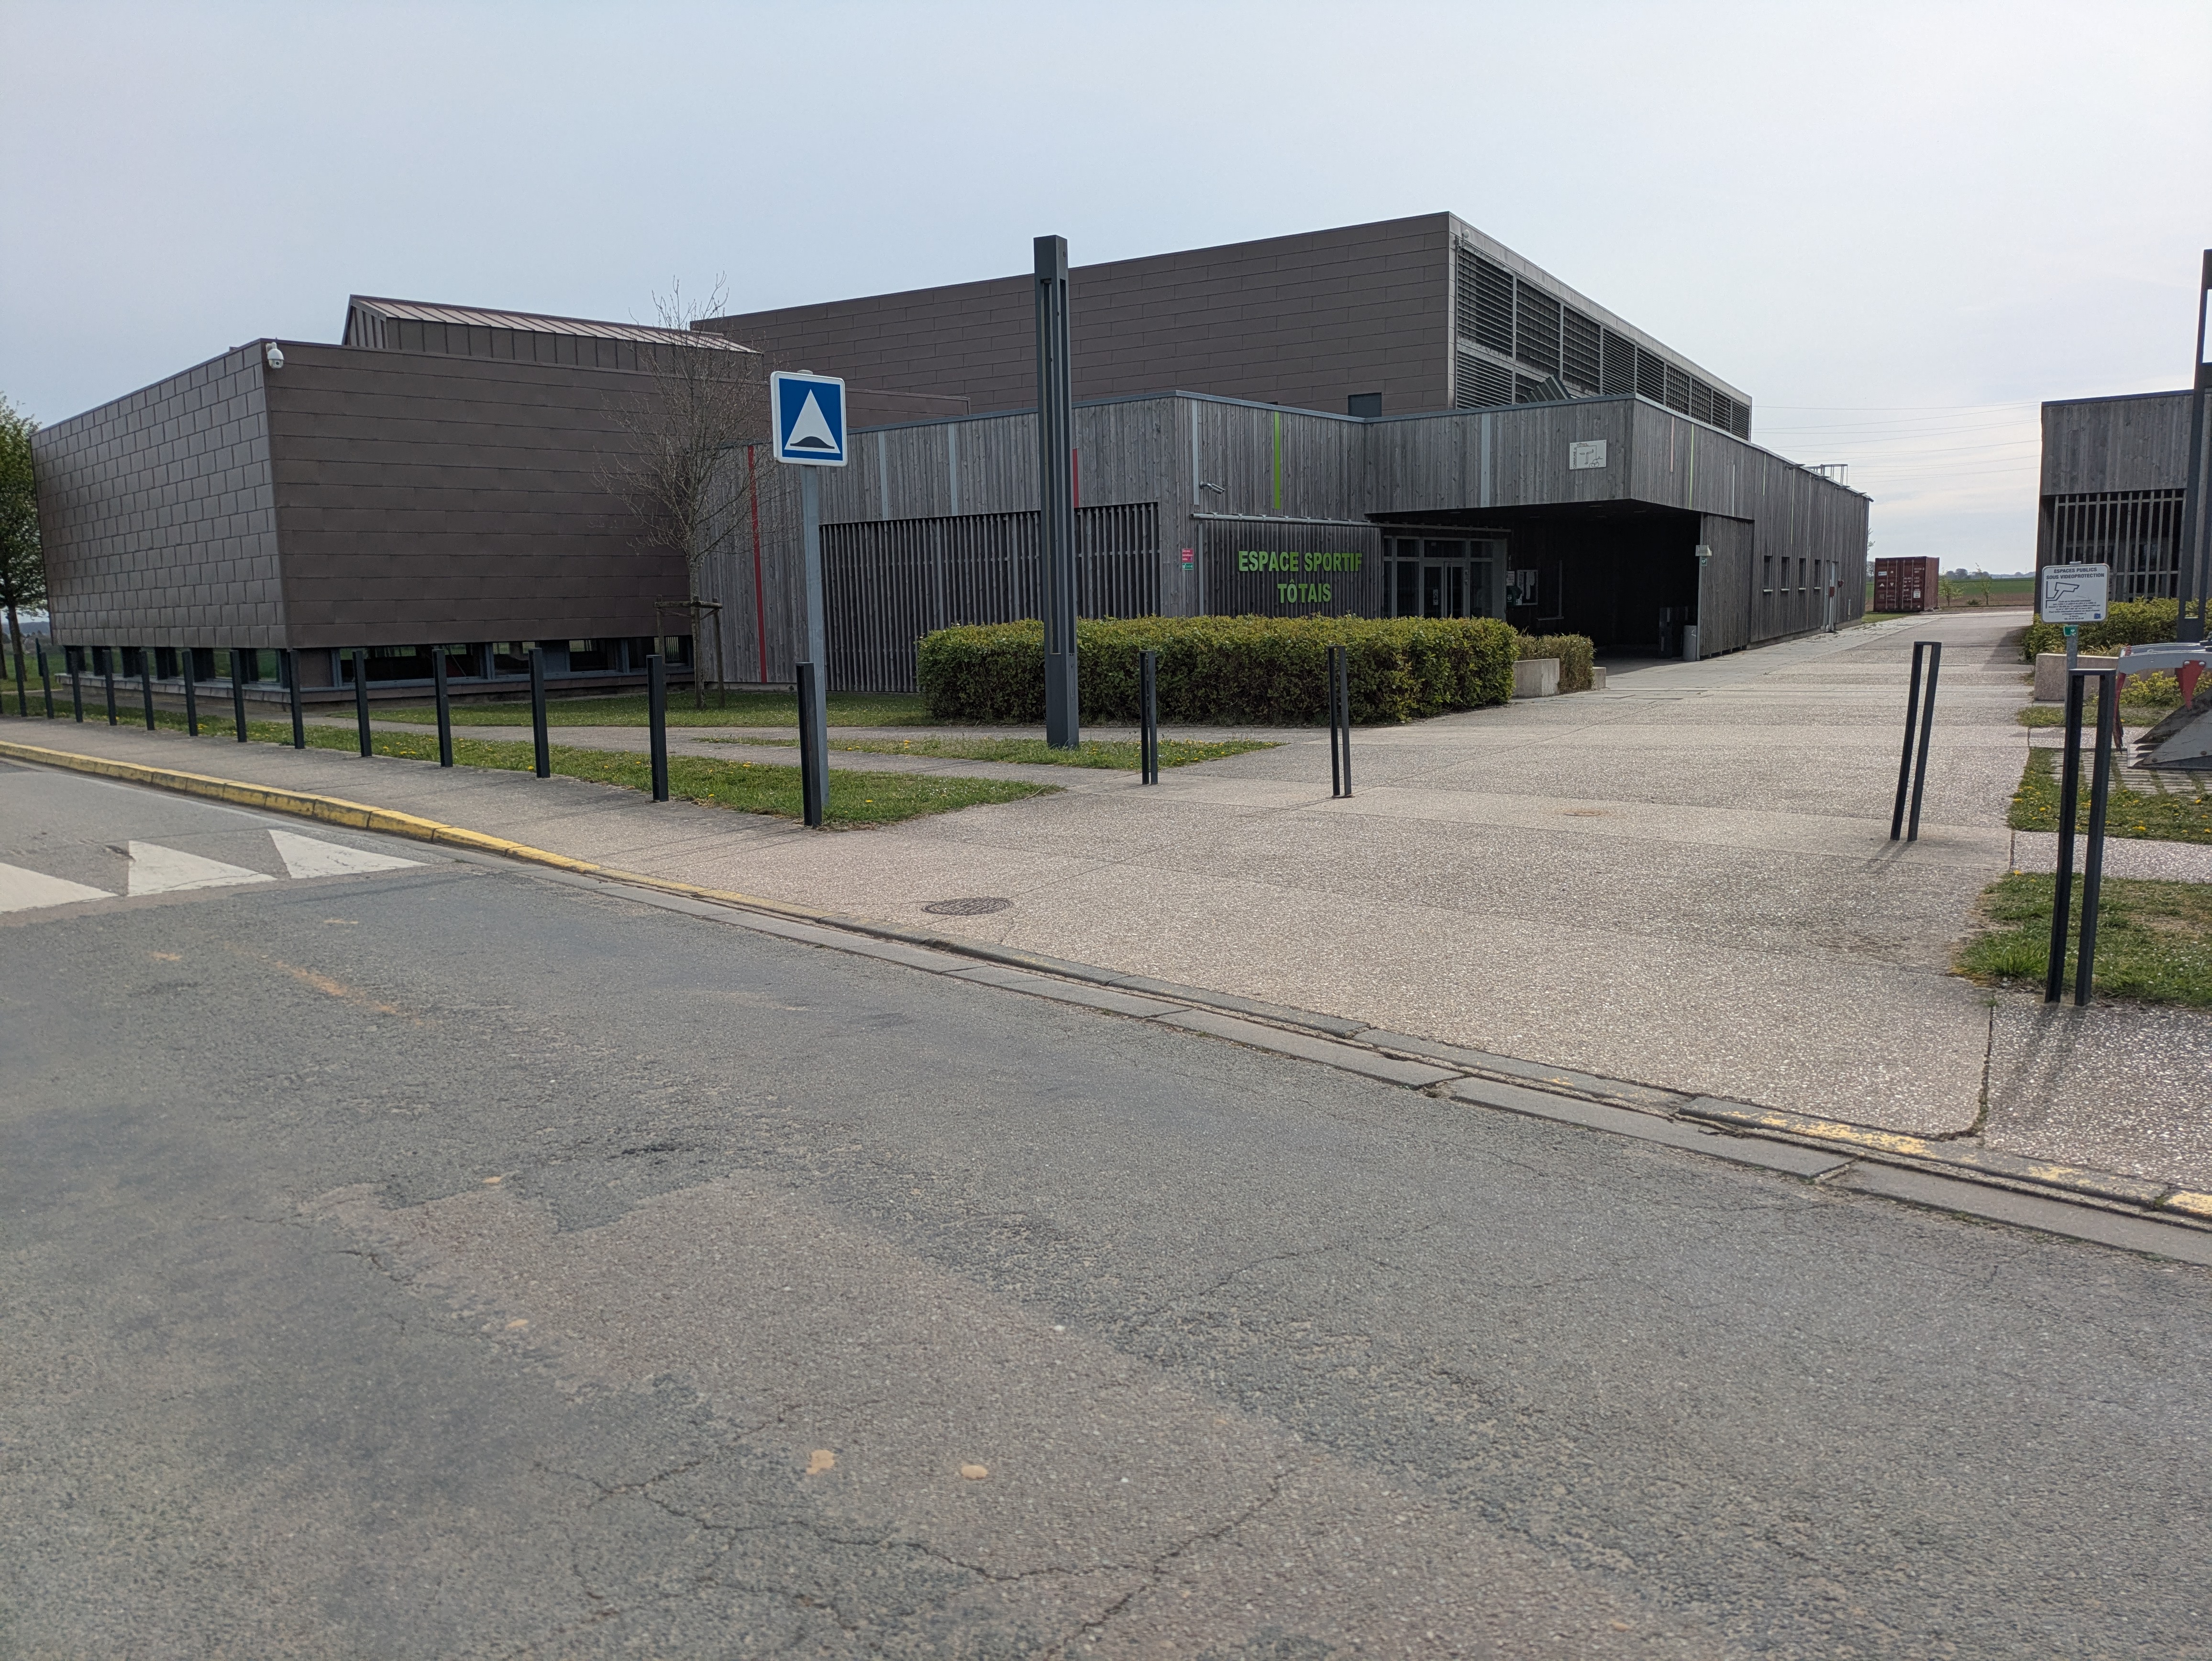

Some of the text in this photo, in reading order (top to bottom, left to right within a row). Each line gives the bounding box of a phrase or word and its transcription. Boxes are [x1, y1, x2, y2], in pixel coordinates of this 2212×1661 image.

[1239, 551, 1362, 572] ESPACE SPORTIF
[1277, 578, 1331, 604] TÔTAIS
